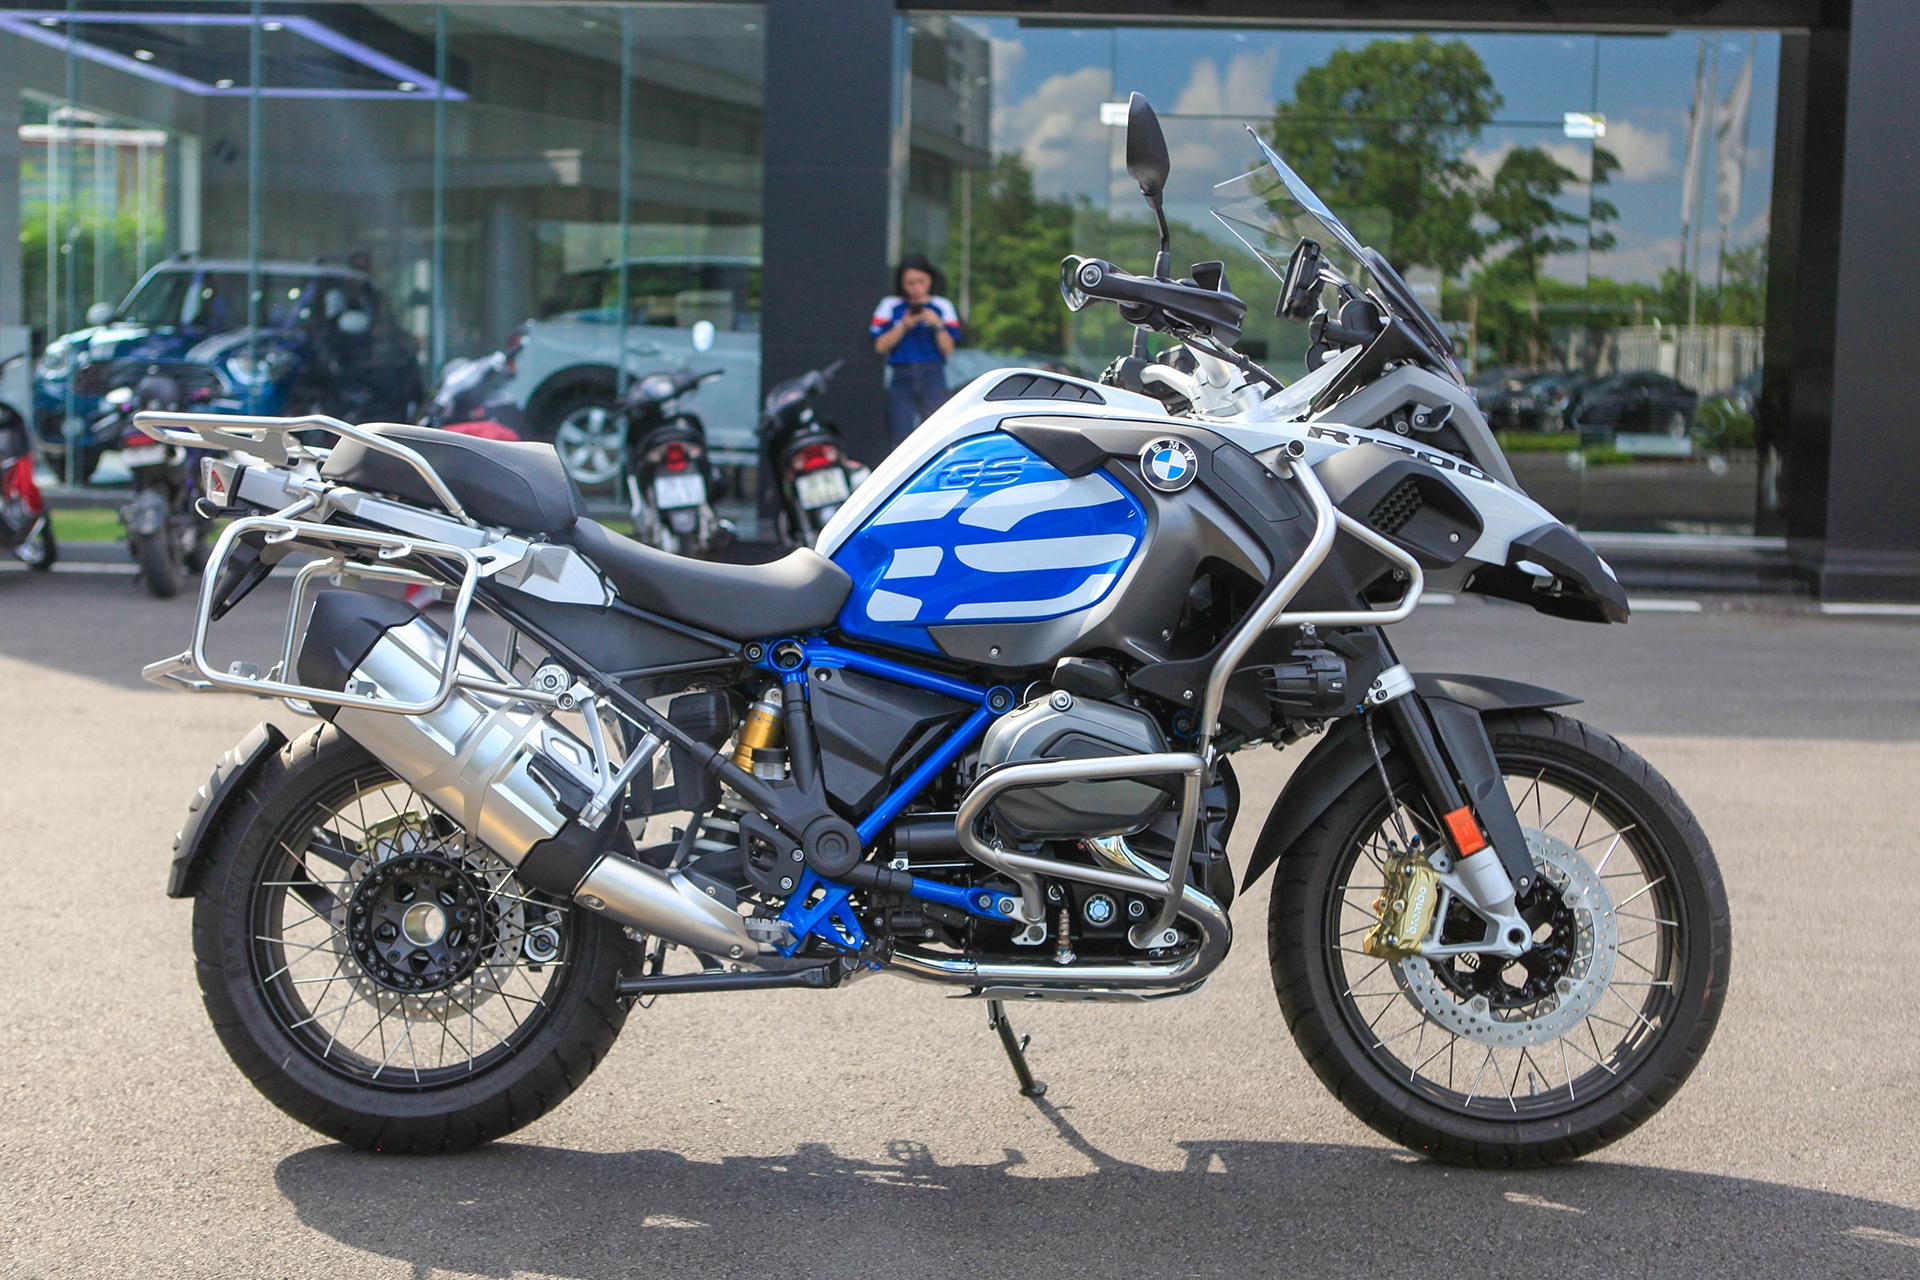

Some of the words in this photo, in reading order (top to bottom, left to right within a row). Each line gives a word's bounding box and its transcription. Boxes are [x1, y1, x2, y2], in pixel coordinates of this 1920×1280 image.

[1150, 440, 1195, 461] BMW
[935, 456, 1028, 489] GS
[1406, 886, 1427, 935] brembo
